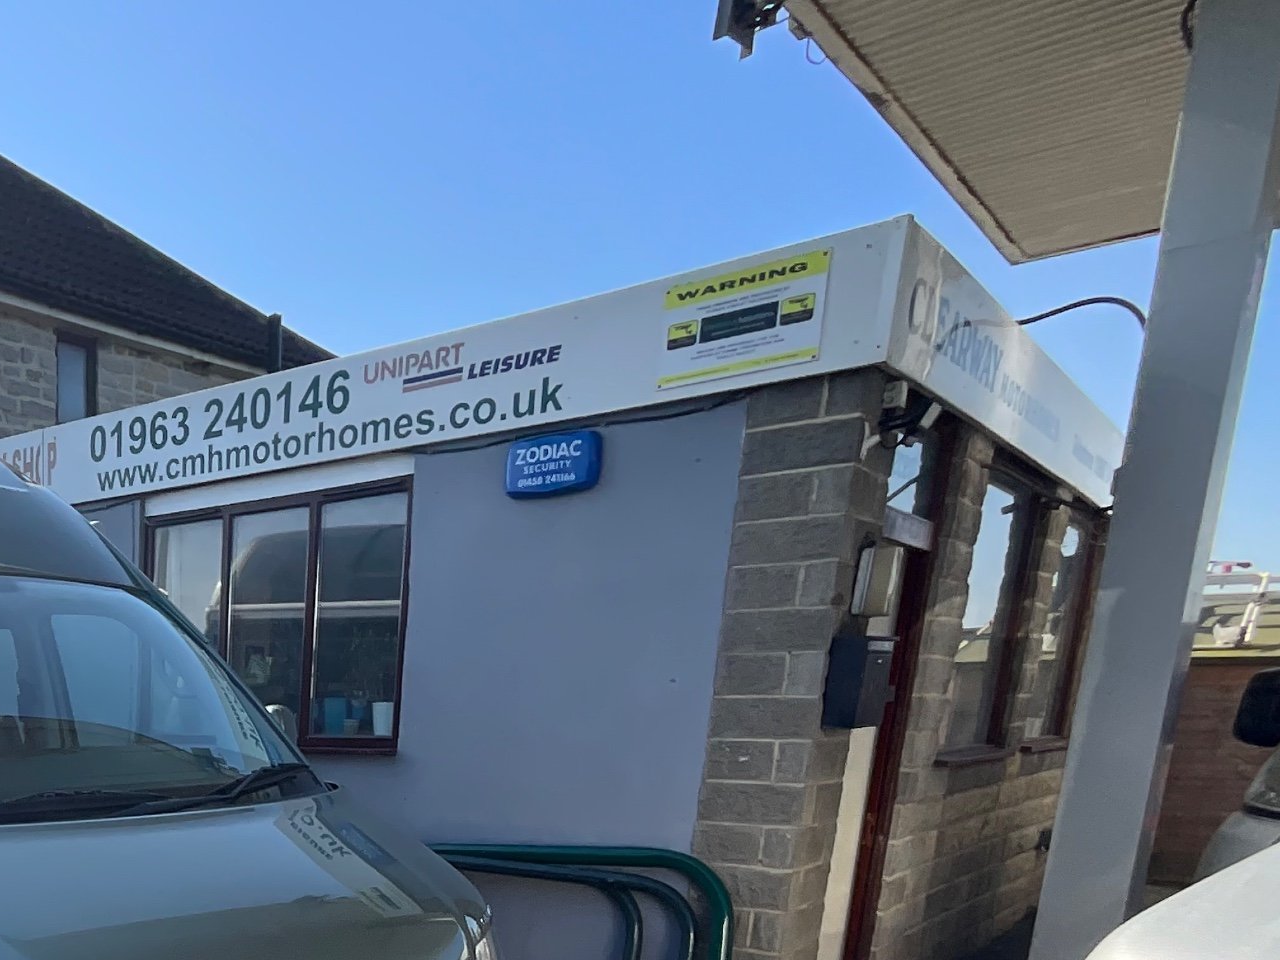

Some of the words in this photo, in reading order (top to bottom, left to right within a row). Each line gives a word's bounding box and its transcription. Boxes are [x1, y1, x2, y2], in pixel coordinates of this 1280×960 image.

[676, 262, 808, 301] WARNING
[363, 342, 465, 385] UNIPART
[467, 344, 562, 380] LEISURE
[90, 406, 190, 462] 01963
[203, 369, 350, 440] 240146
[97, 376, 563, 492] www.cmhmotorhomes.co.uk
[515, 439, 582, 466] ZODIAC
[523, 459, 572, 475] SECURITY
